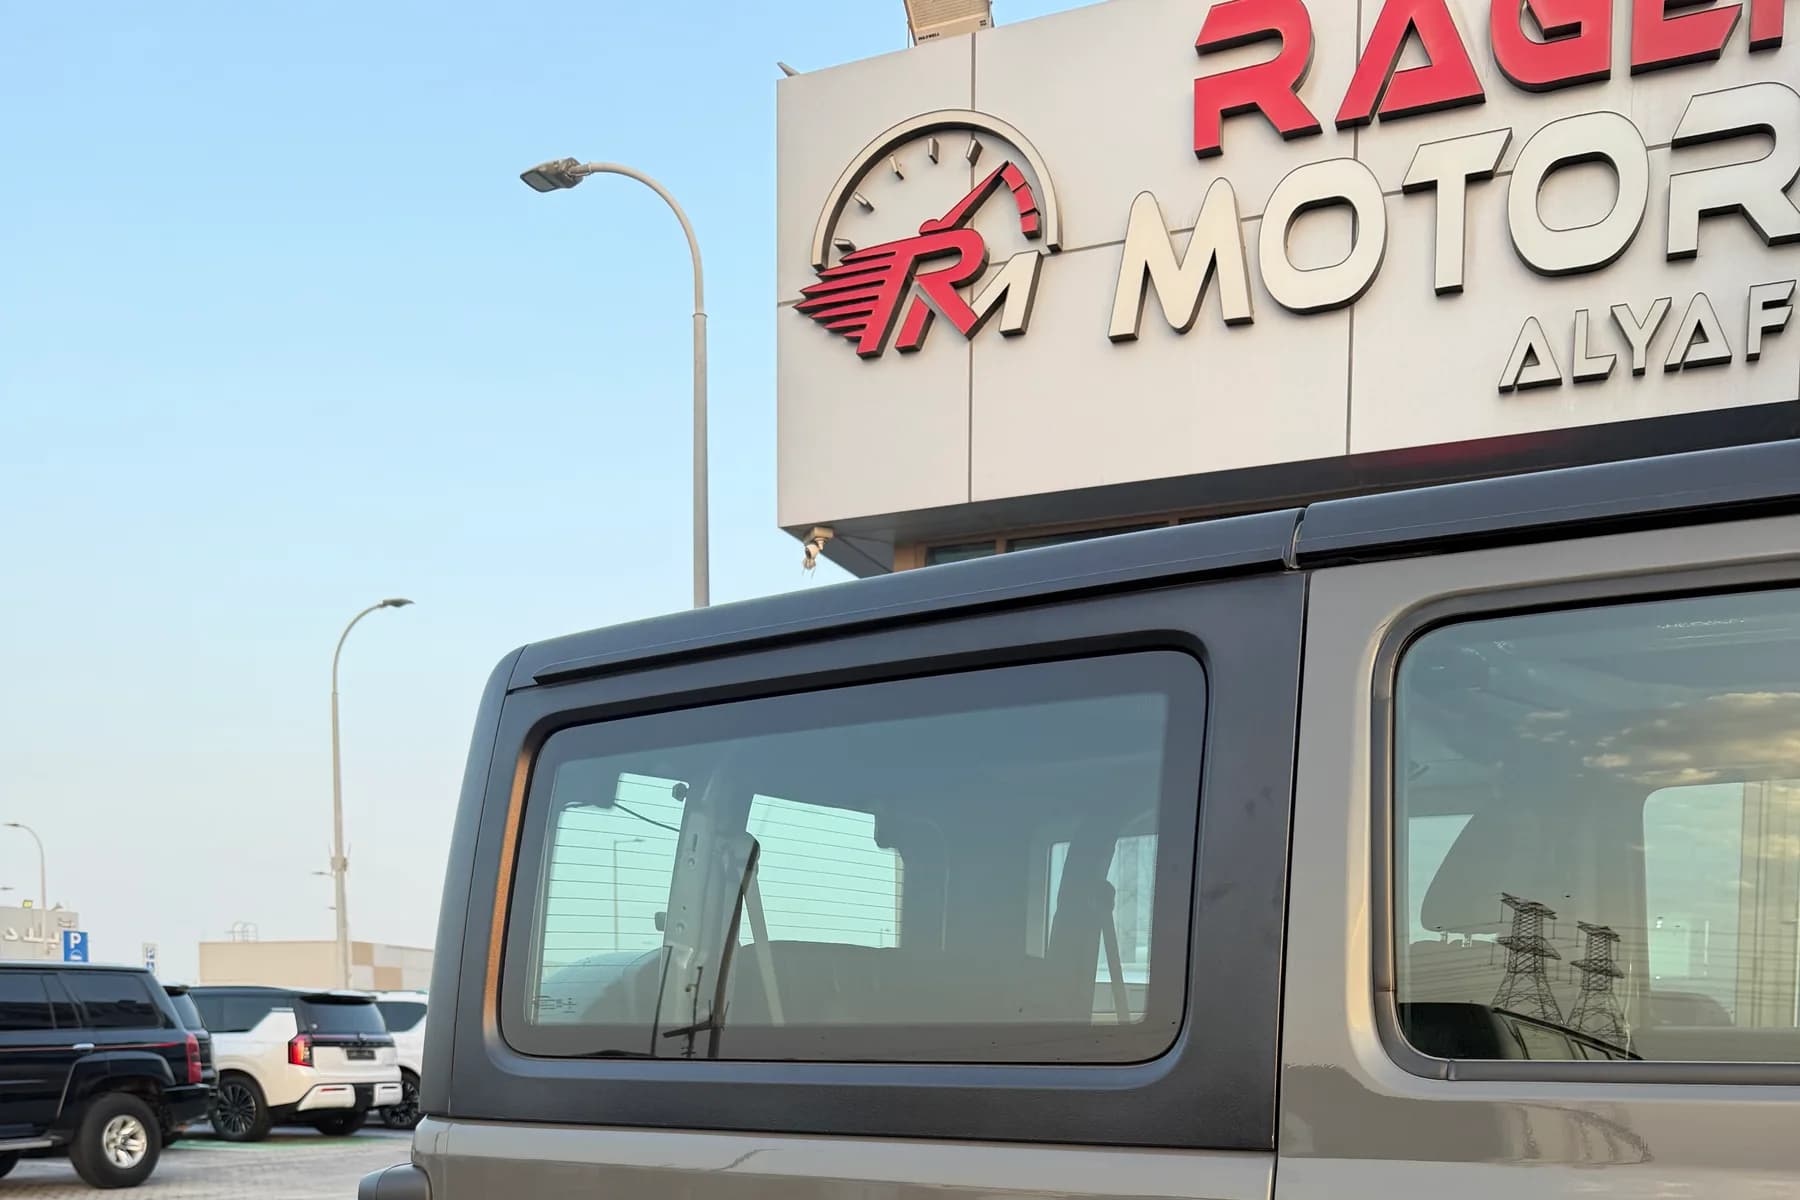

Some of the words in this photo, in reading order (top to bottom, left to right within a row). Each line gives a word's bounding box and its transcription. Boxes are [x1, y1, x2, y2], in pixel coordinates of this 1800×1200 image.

[1108, 81, 1800, 342] MOTOR
[1498, 279, 1797, 394] ALYAF
[69, 932, 82, 949] P
